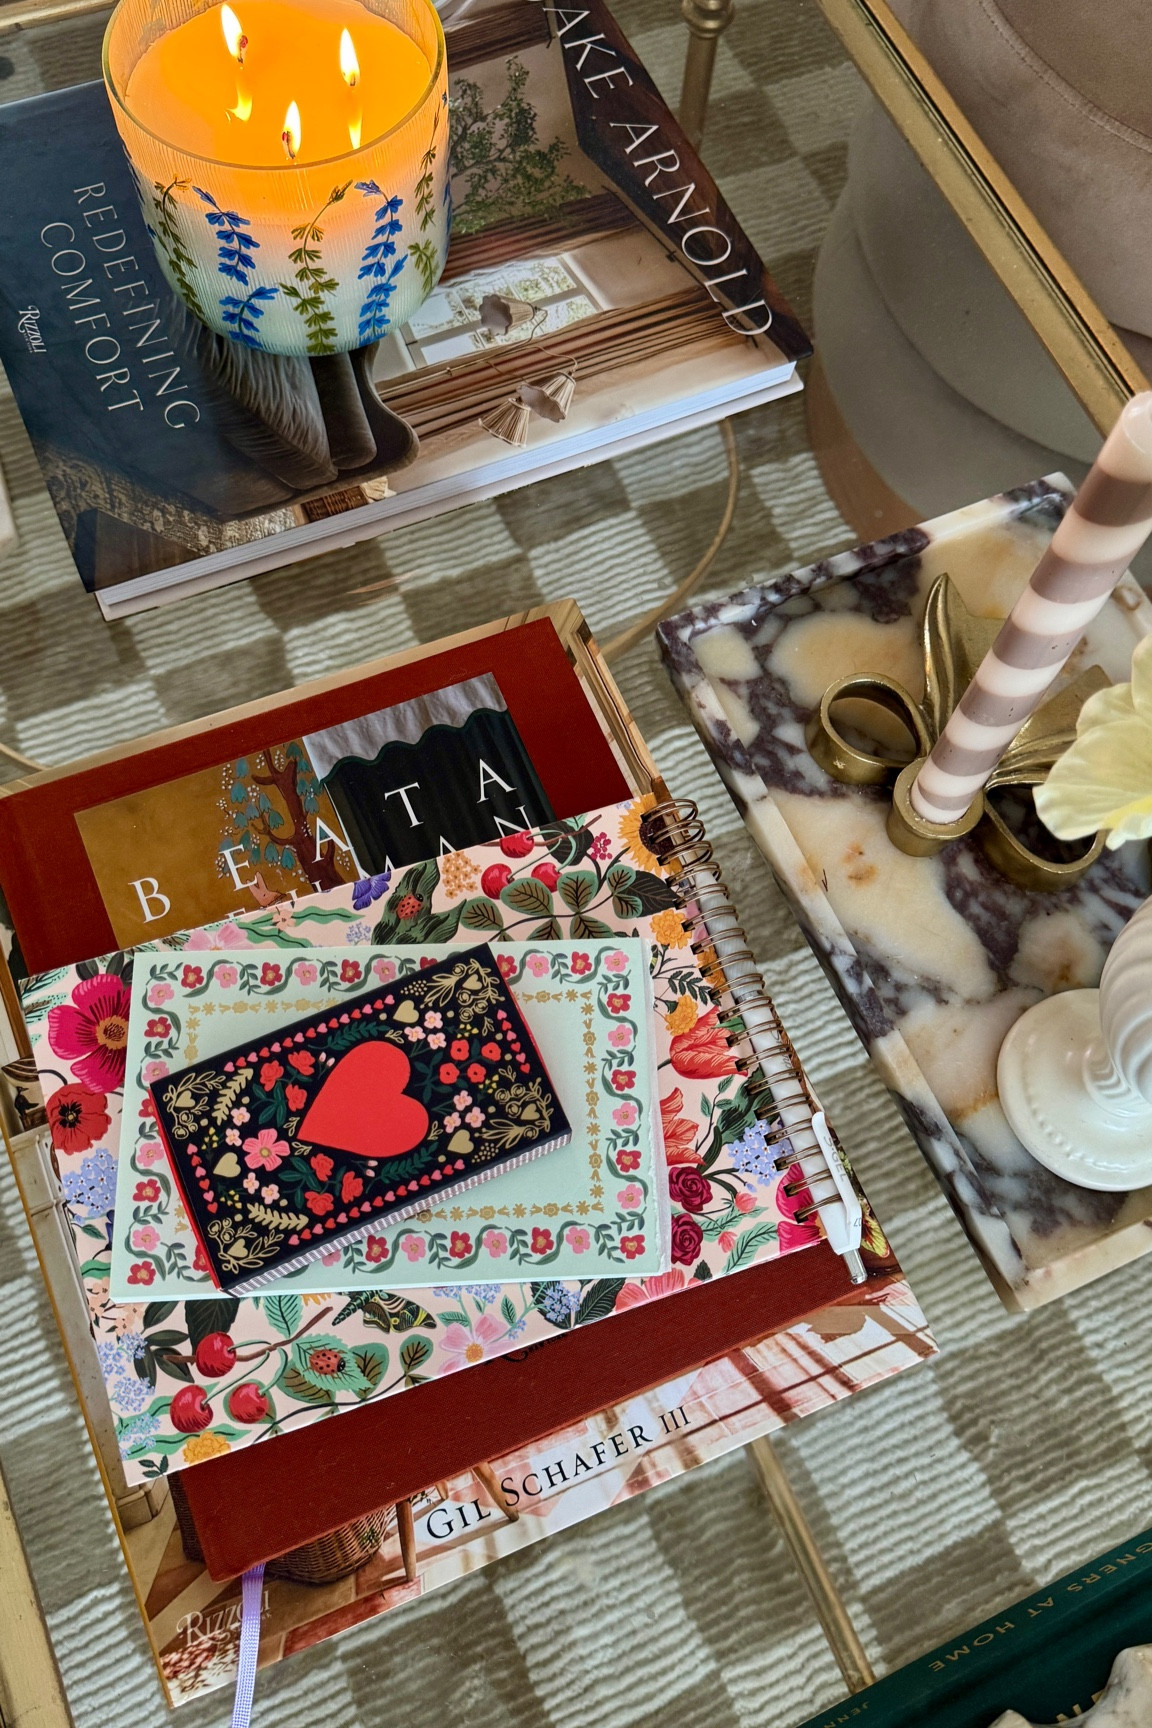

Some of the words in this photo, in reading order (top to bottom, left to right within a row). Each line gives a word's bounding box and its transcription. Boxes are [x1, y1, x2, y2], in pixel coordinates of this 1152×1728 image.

[528, 0, 633, 99] AKE
[610, 122, 773, 335] ARNOLD
[18, 305, 47, 353] RIZZOLI
[41, 222, 144, 411] COMFORT
[74, 182, 200, 429] REDEFINING
[128, 758, 517, 924] BEATA
[426, 1498, 491, 1539] GIL
[501, 1424, 653, 1507] SCHAFER
[658, 1406, 692, 1434] III
[1027, 1597, 1055, 1618] AT
[1067, 1542, 1152, 1592] GNERS
[176, 1590, 271, 1646] RIZZI
[928, 1621, 1015, 1672] HOME
